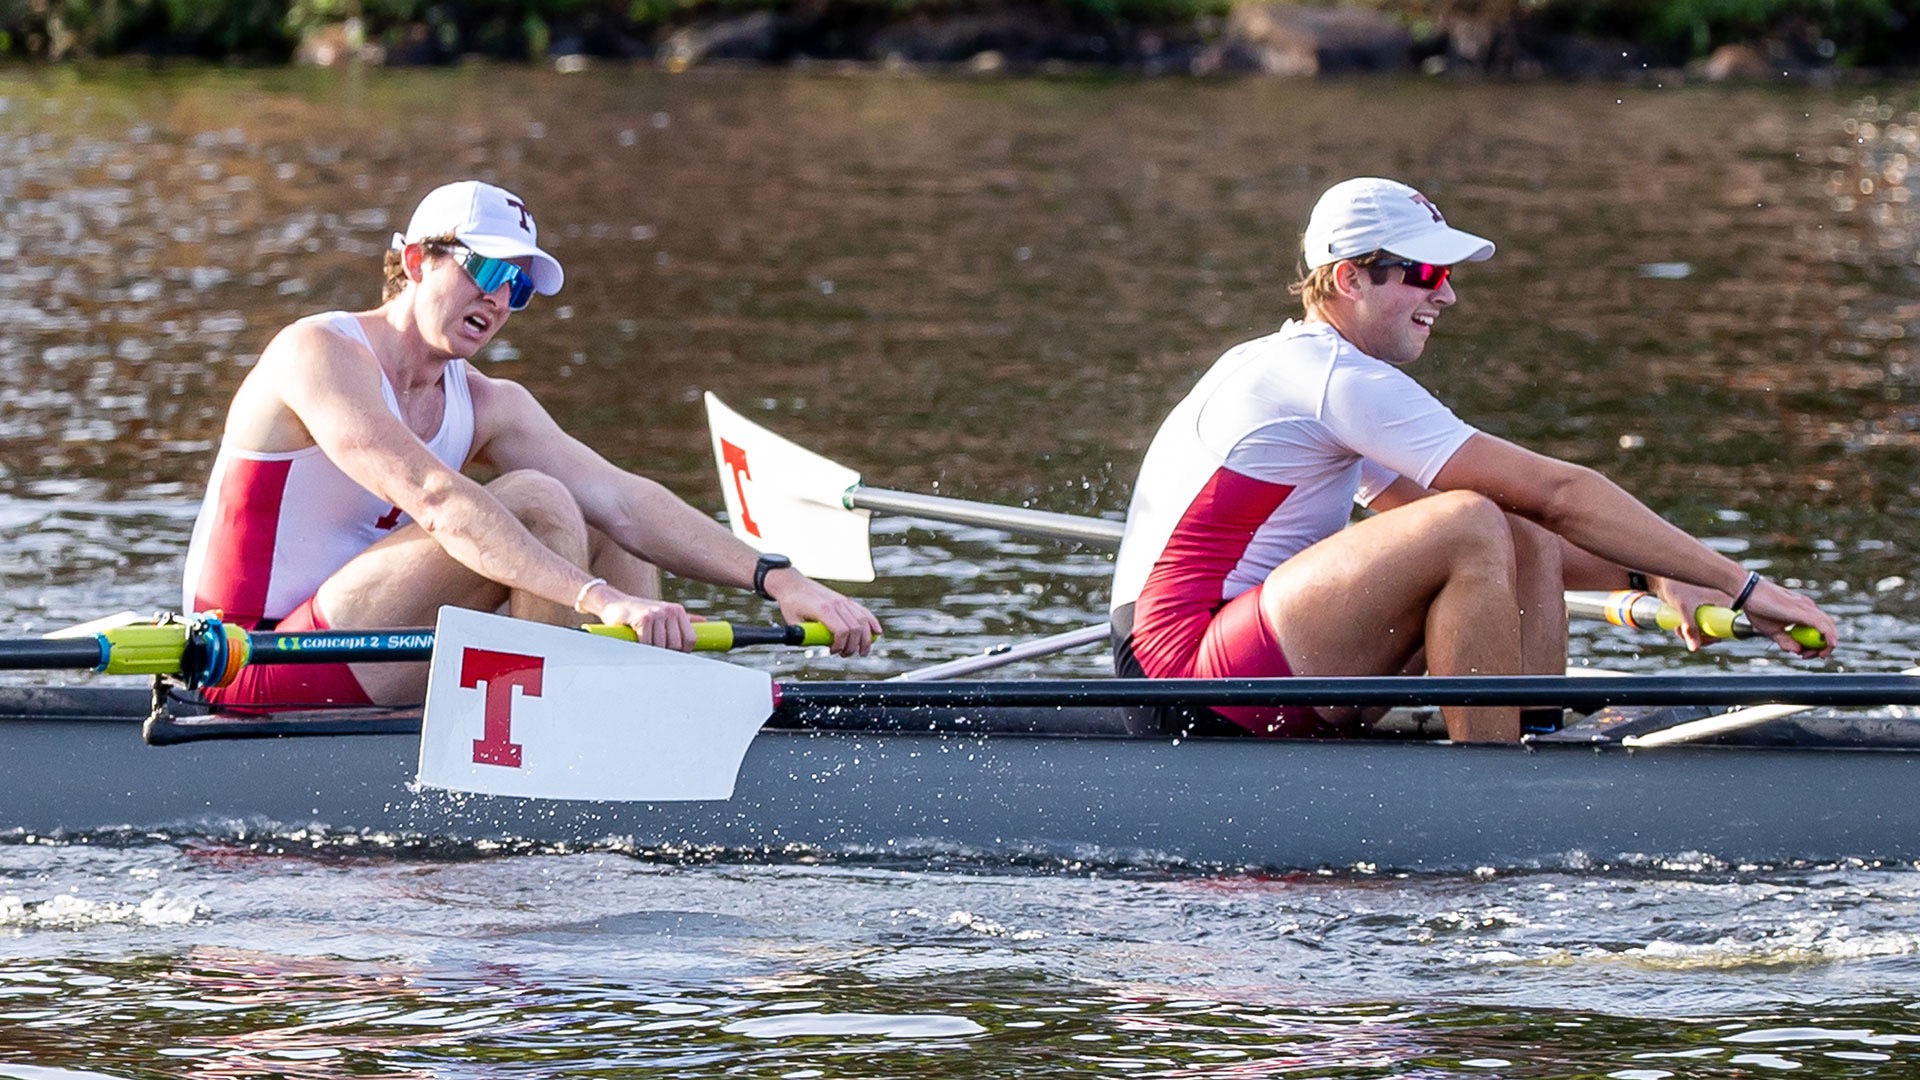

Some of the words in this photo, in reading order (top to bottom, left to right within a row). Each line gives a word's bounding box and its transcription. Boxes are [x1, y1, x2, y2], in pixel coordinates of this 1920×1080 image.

[506, 198, 531, 233] T
[720, 436, 762, 539] T
[302, 636, 366, 650] concept
[370, 636, 380, 648] 2
[460, 647, 545, 768] T
